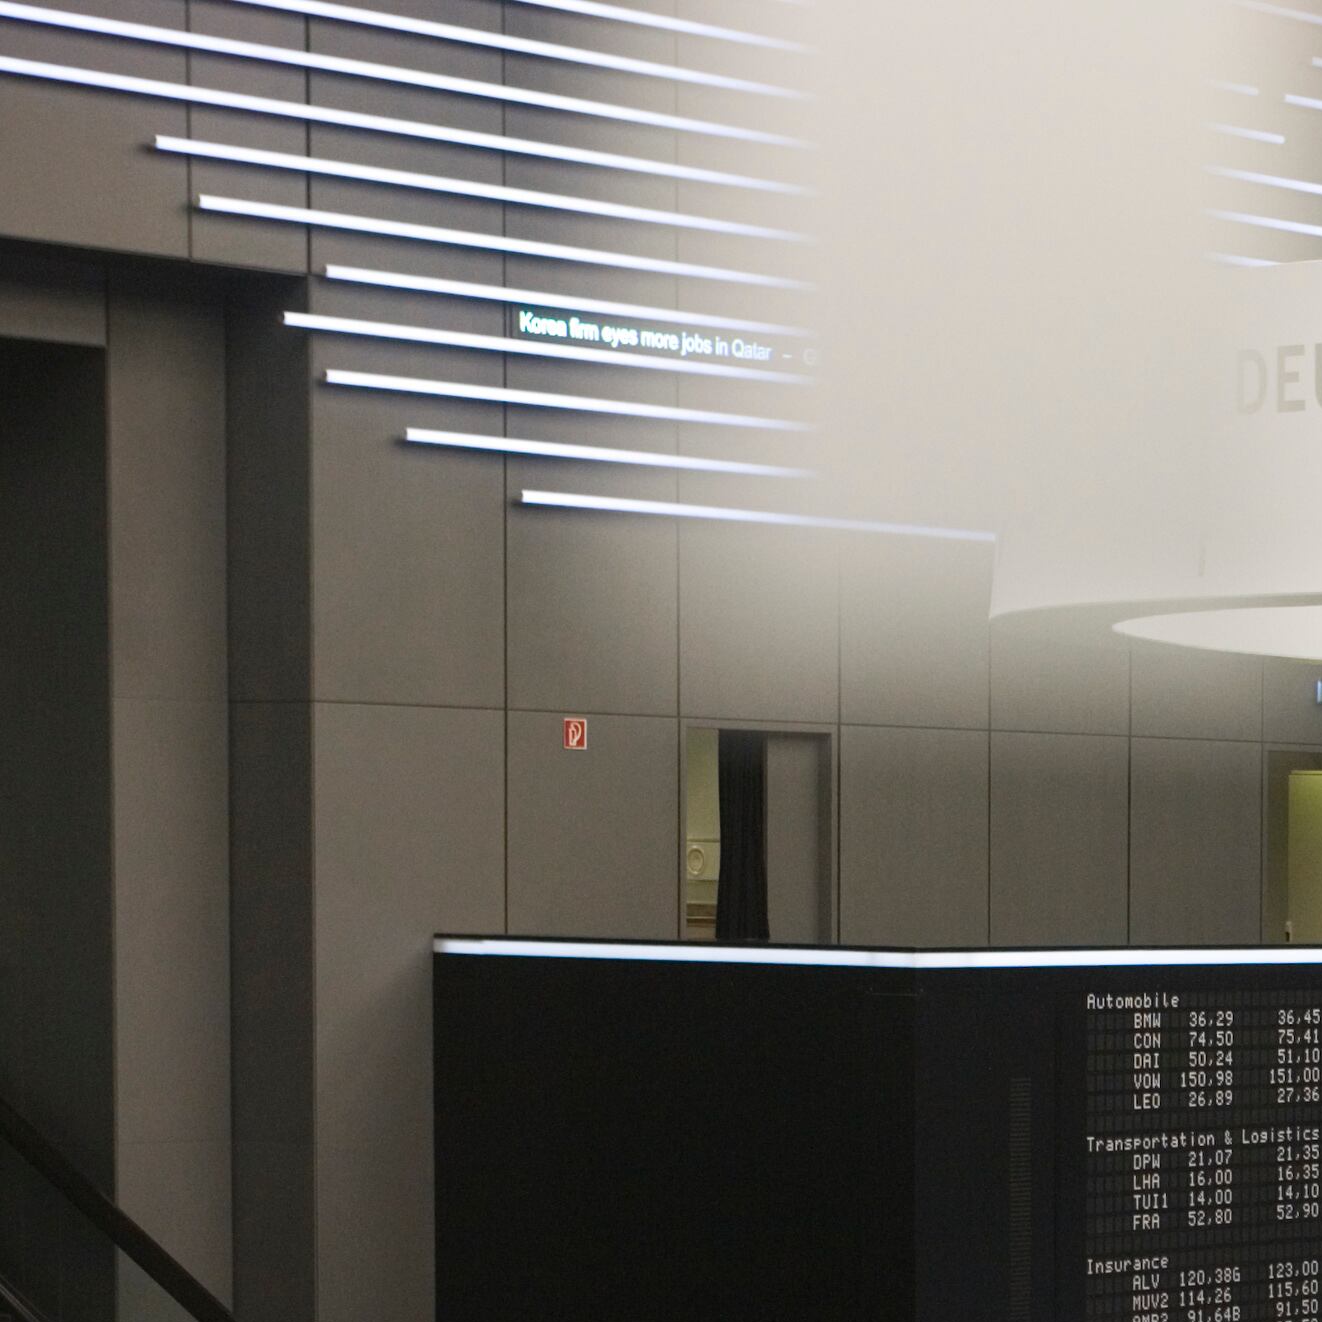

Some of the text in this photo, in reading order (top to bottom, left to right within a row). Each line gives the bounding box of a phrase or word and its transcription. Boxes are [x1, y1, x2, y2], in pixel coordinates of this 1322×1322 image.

[520, 311, 771, 362] Korea firm eyes more jobs in Qatar
[1087, 995, 1178, 1008] Automobile
[1134, 1011, 1233, 1028] BMW 36,29
[1134, 1031, 1233, 1048] CON 74,50
[1134, 1051, 1232, 1068] DAI 50,24
[1134, 1071, 1232, 1088] VOW 150,98
[1134, 1091, 1232, 1109] LEO 26,89
[1087, 1129, 1319, 1150] Transportation & Logistics
[1134, 1150, 1232, 1169] DPW 21,07
[1134, 1170, 1232, 1190] LHA 16,00
[1134, 1190, 1232, 1209] TUI1 14,00
[1134, 1209, 1232, 1229] FRA 52,80
[1088, 1258, 1168, 1273] Insurance
[1133, 1275, 1159, 1290] ALV
[1133, 1294, 1168, 1310] MUV2
